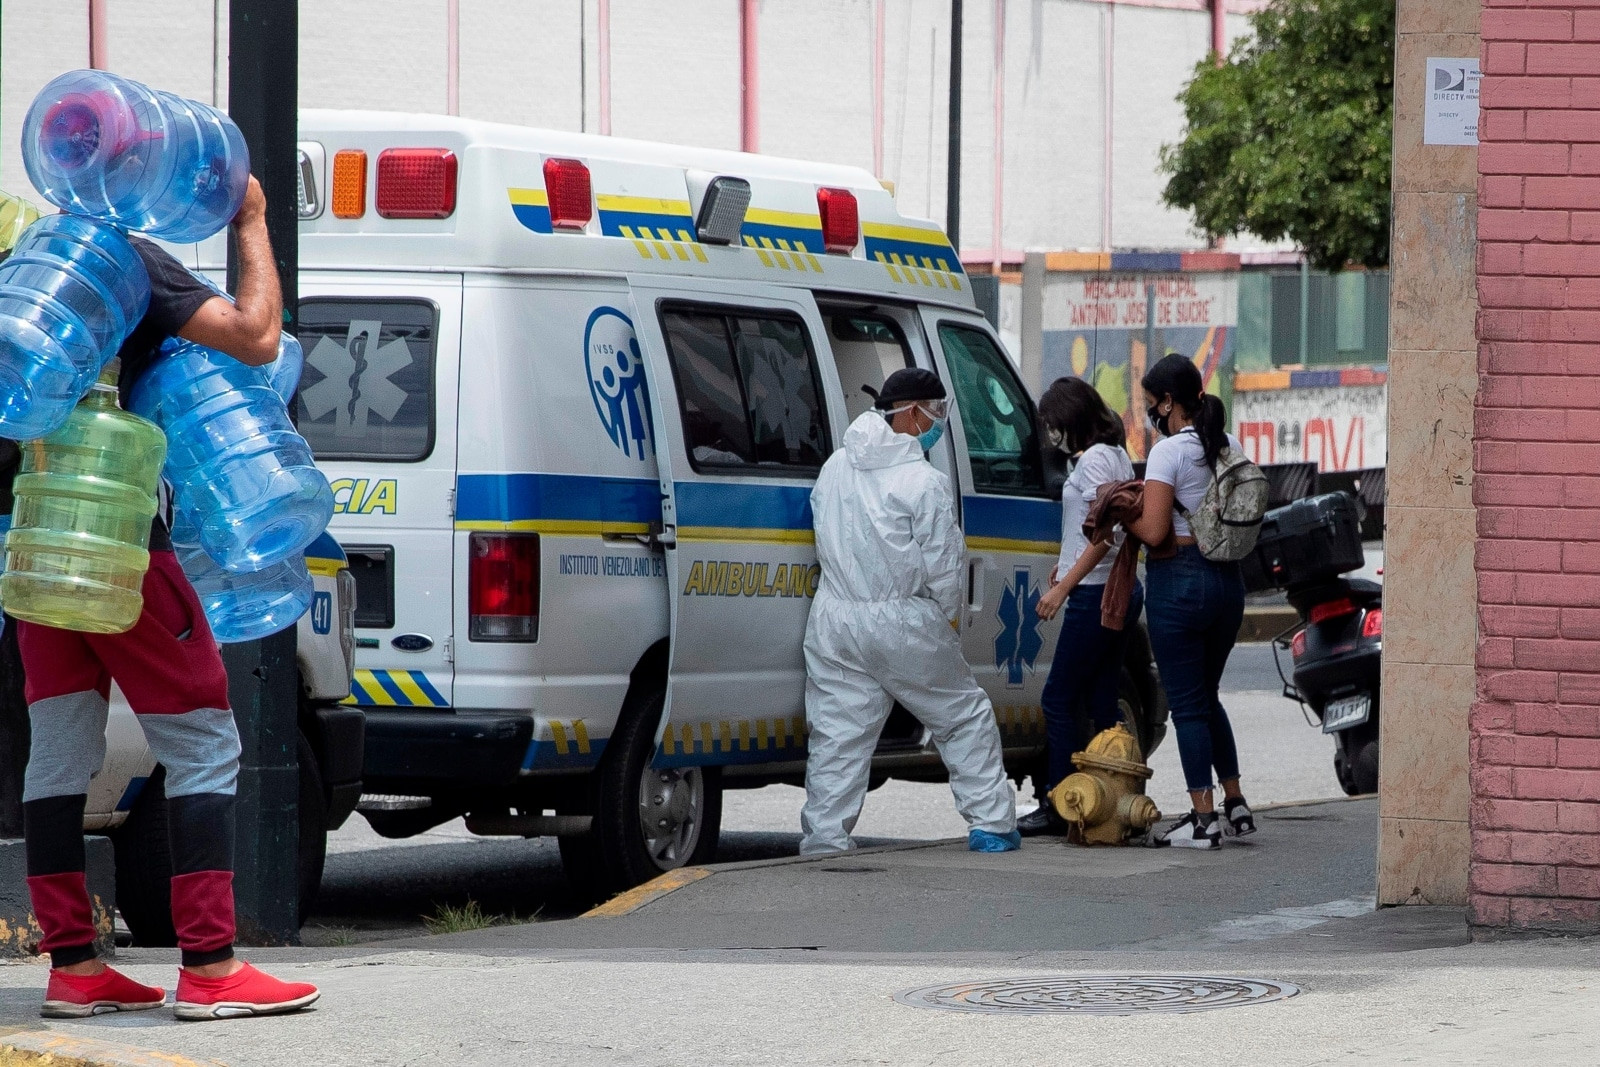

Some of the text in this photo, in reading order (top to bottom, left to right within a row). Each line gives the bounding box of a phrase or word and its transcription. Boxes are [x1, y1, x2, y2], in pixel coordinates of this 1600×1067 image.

[1433, 93, 1465, 101] DIRECTV
[1157, 301, 1171, 325] DE
[593, 344, 614, 355] IVSS
[559, 554, 598, 576] INSTITUTO
[601, 556, 650, 577] VENEZOLANO
[652, 557, 663, 577] DE
[315, 597, 328, 629] 41
